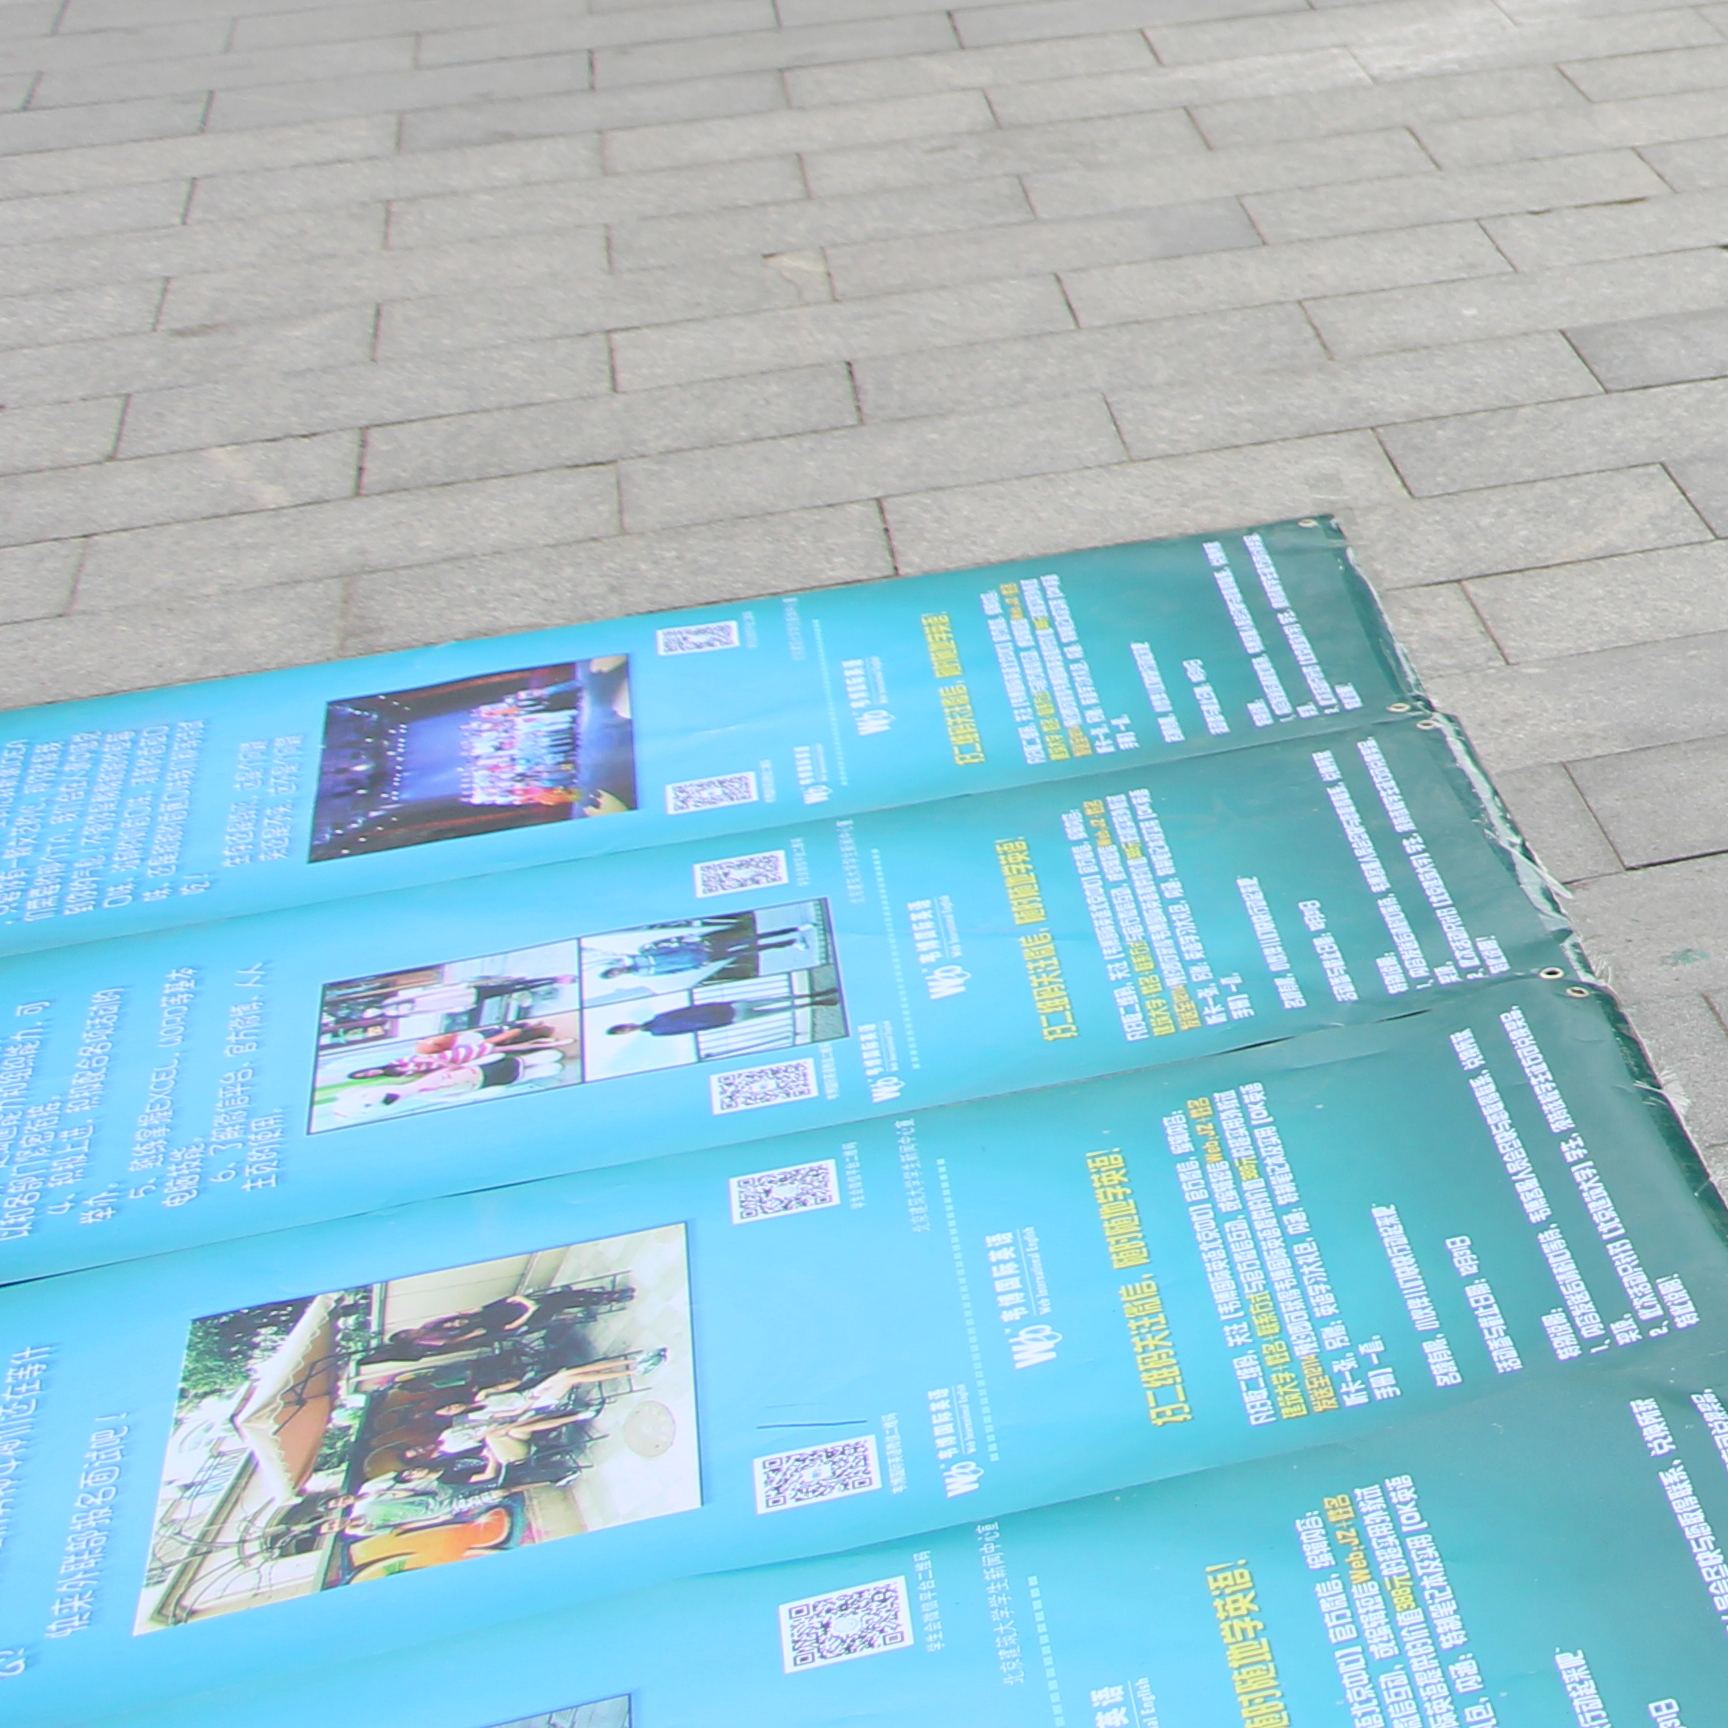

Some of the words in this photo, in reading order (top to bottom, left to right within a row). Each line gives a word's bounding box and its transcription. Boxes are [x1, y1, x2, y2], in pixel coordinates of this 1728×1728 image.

[983, 1229, 1030, 1323] 韦博国际英语
[1083, 1145, 1196, 1427] 扫二维码关注微信，随时随地学英语！
[1006, 1319, 1067, 1369] Web
[1538, 1305, 1584, 1360] 特别说明：
[45, 1407, 130, 1642] 快来外联部报名面试吧！
[1554, 1647, 1613, 1728] 行动起来吧~
